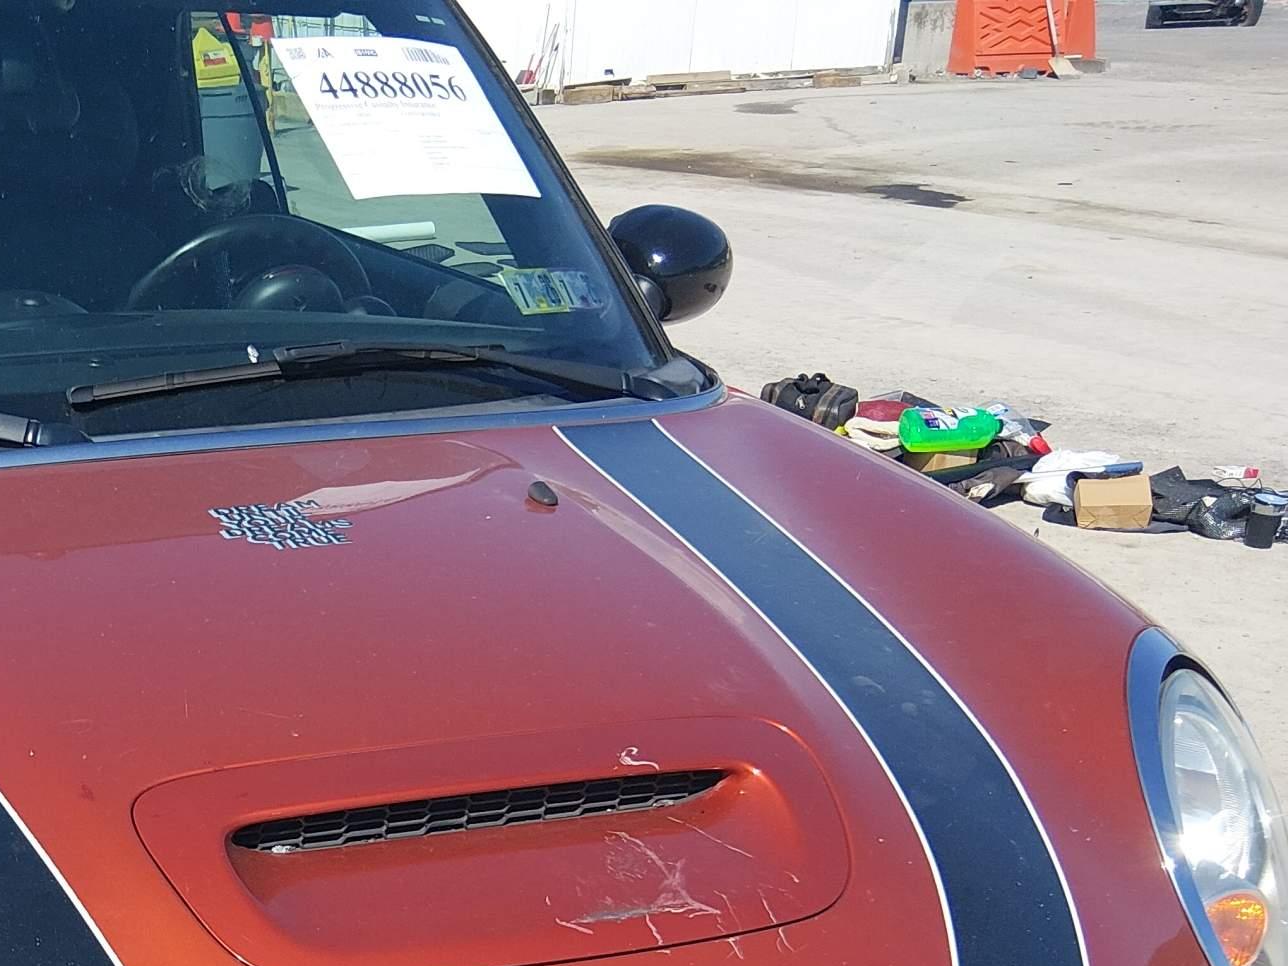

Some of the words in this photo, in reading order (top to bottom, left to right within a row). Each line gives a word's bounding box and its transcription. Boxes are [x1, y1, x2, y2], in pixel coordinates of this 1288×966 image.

[319, 71, 466, 101] 44888056
[208, 499, 321, 517] DREAM
[218, 519, 354, 540] DREAMS
[267, 534, 353, 550] TRUE
